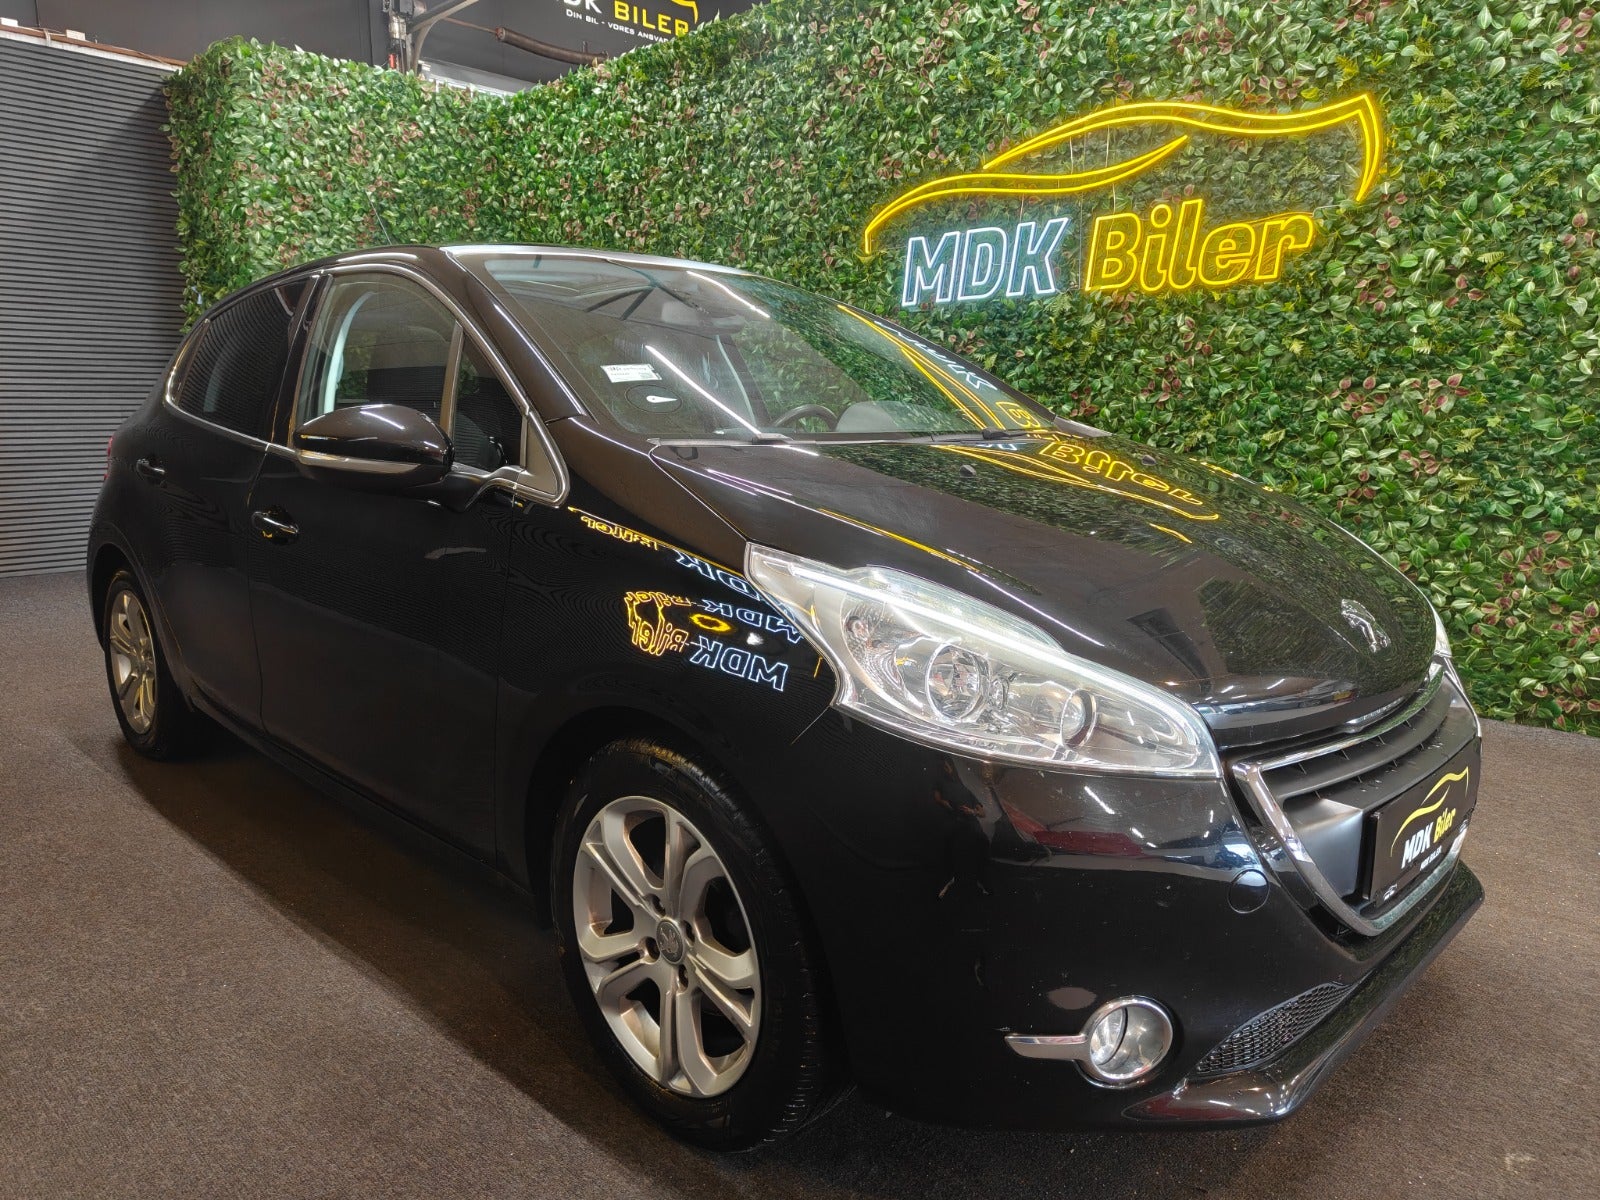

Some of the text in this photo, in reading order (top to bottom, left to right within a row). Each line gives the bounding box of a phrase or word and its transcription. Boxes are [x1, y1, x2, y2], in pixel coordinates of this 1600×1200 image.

[565, 8, 583, 20] DIN
[585, 14, 599, 25] BIL
[607, 21, 635, 35] VORES
[901, 198, 1317, 308] MDK Biler
[1401, 822, 1434, 869] MDK
[1433, 807, 1456, 843] Biler
